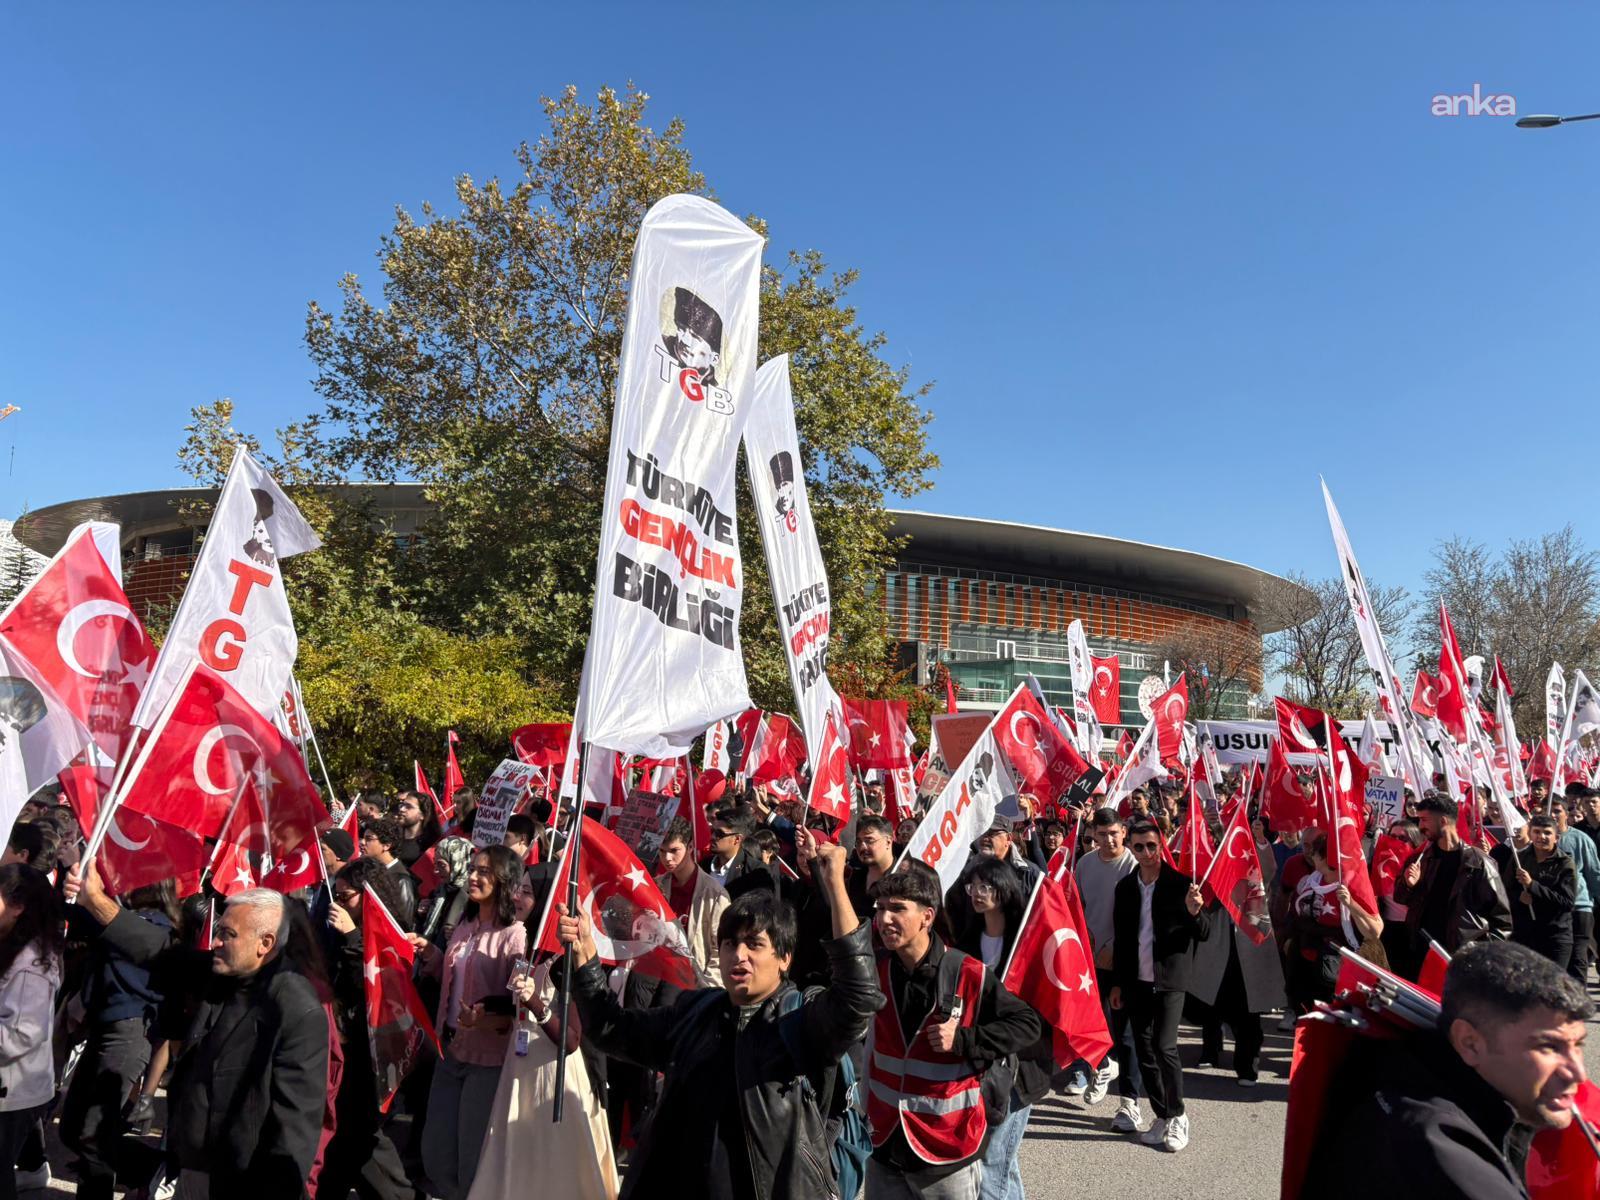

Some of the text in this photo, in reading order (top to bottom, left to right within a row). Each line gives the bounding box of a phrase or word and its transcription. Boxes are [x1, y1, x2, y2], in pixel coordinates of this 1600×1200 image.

[655, 344, 735, 416] TGB
[626, 447, 734, 546] TÜRKİYE
[620, 498, 736, 589] GENÇLİK
[613, 551, 735, 651] BİRLİĞİ
[921, 781, 971, 868] TGB
